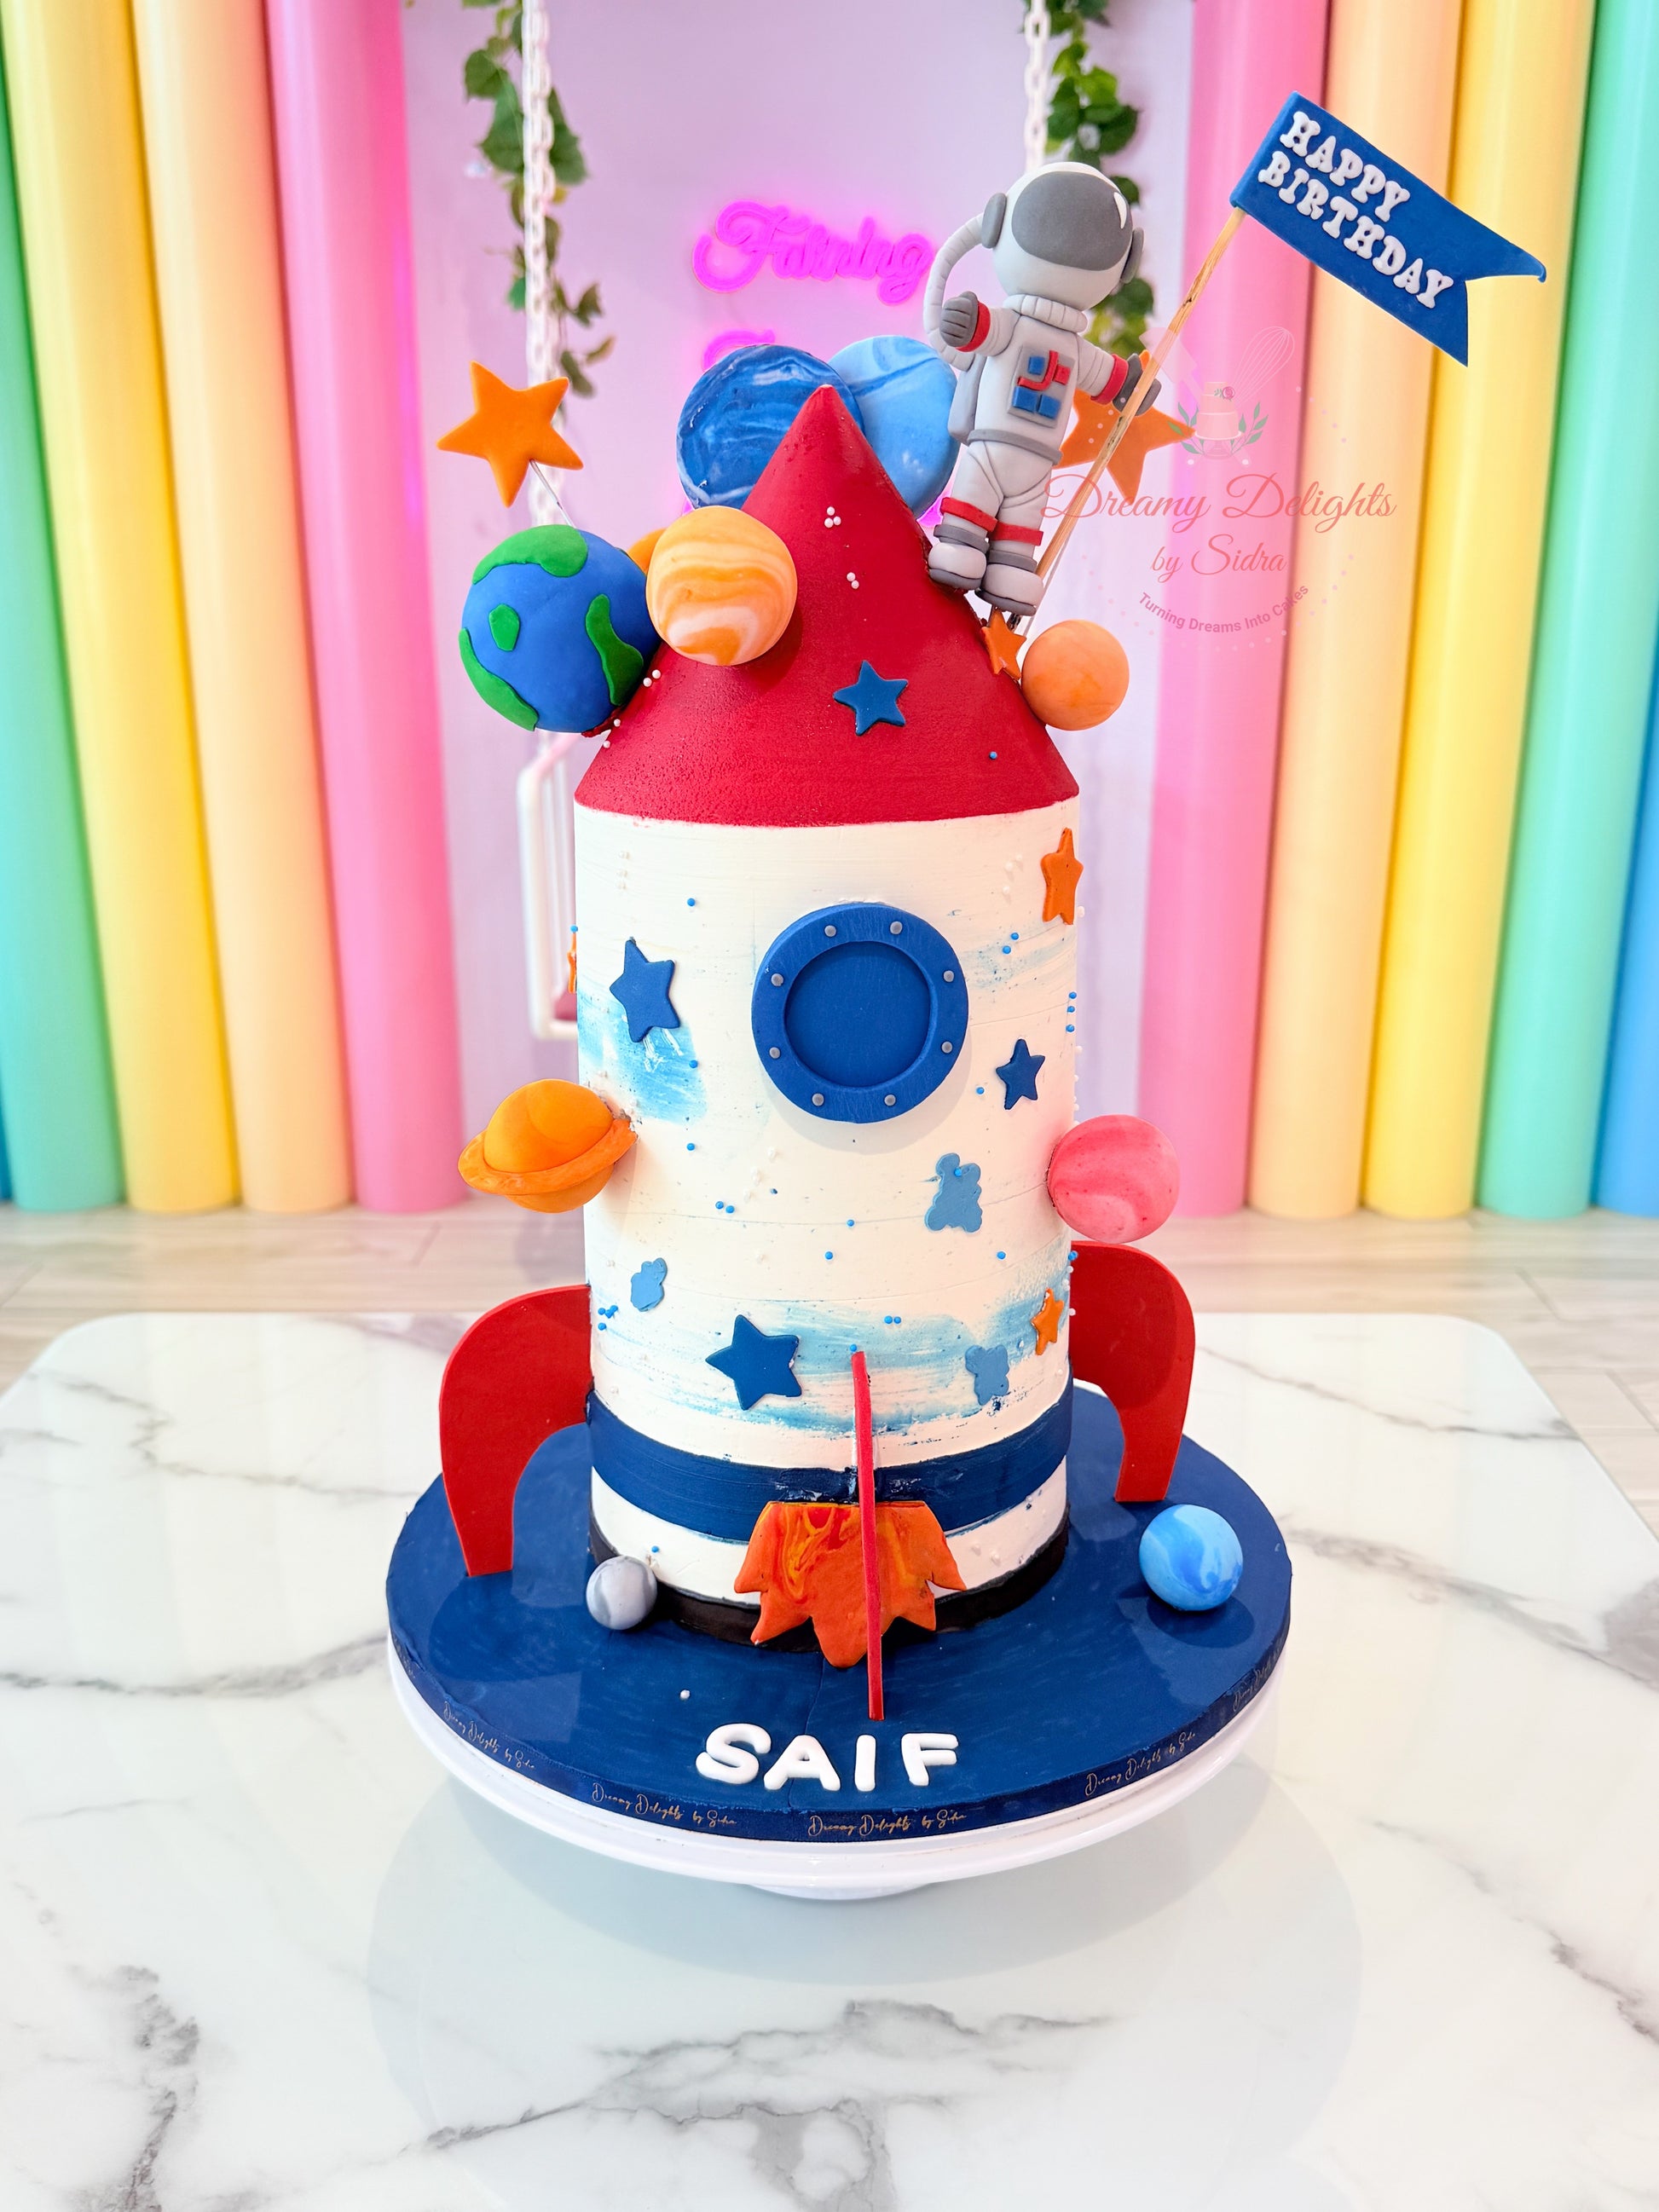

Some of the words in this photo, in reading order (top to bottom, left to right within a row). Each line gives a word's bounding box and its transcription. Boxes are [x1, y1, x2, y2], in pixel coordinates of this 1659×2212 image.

[1280, 111, 1410, 222] HAPPY
[1258, 151, 1454, 309] BIRTHDAY
[695, 1723, 959, 1792] SAIF
